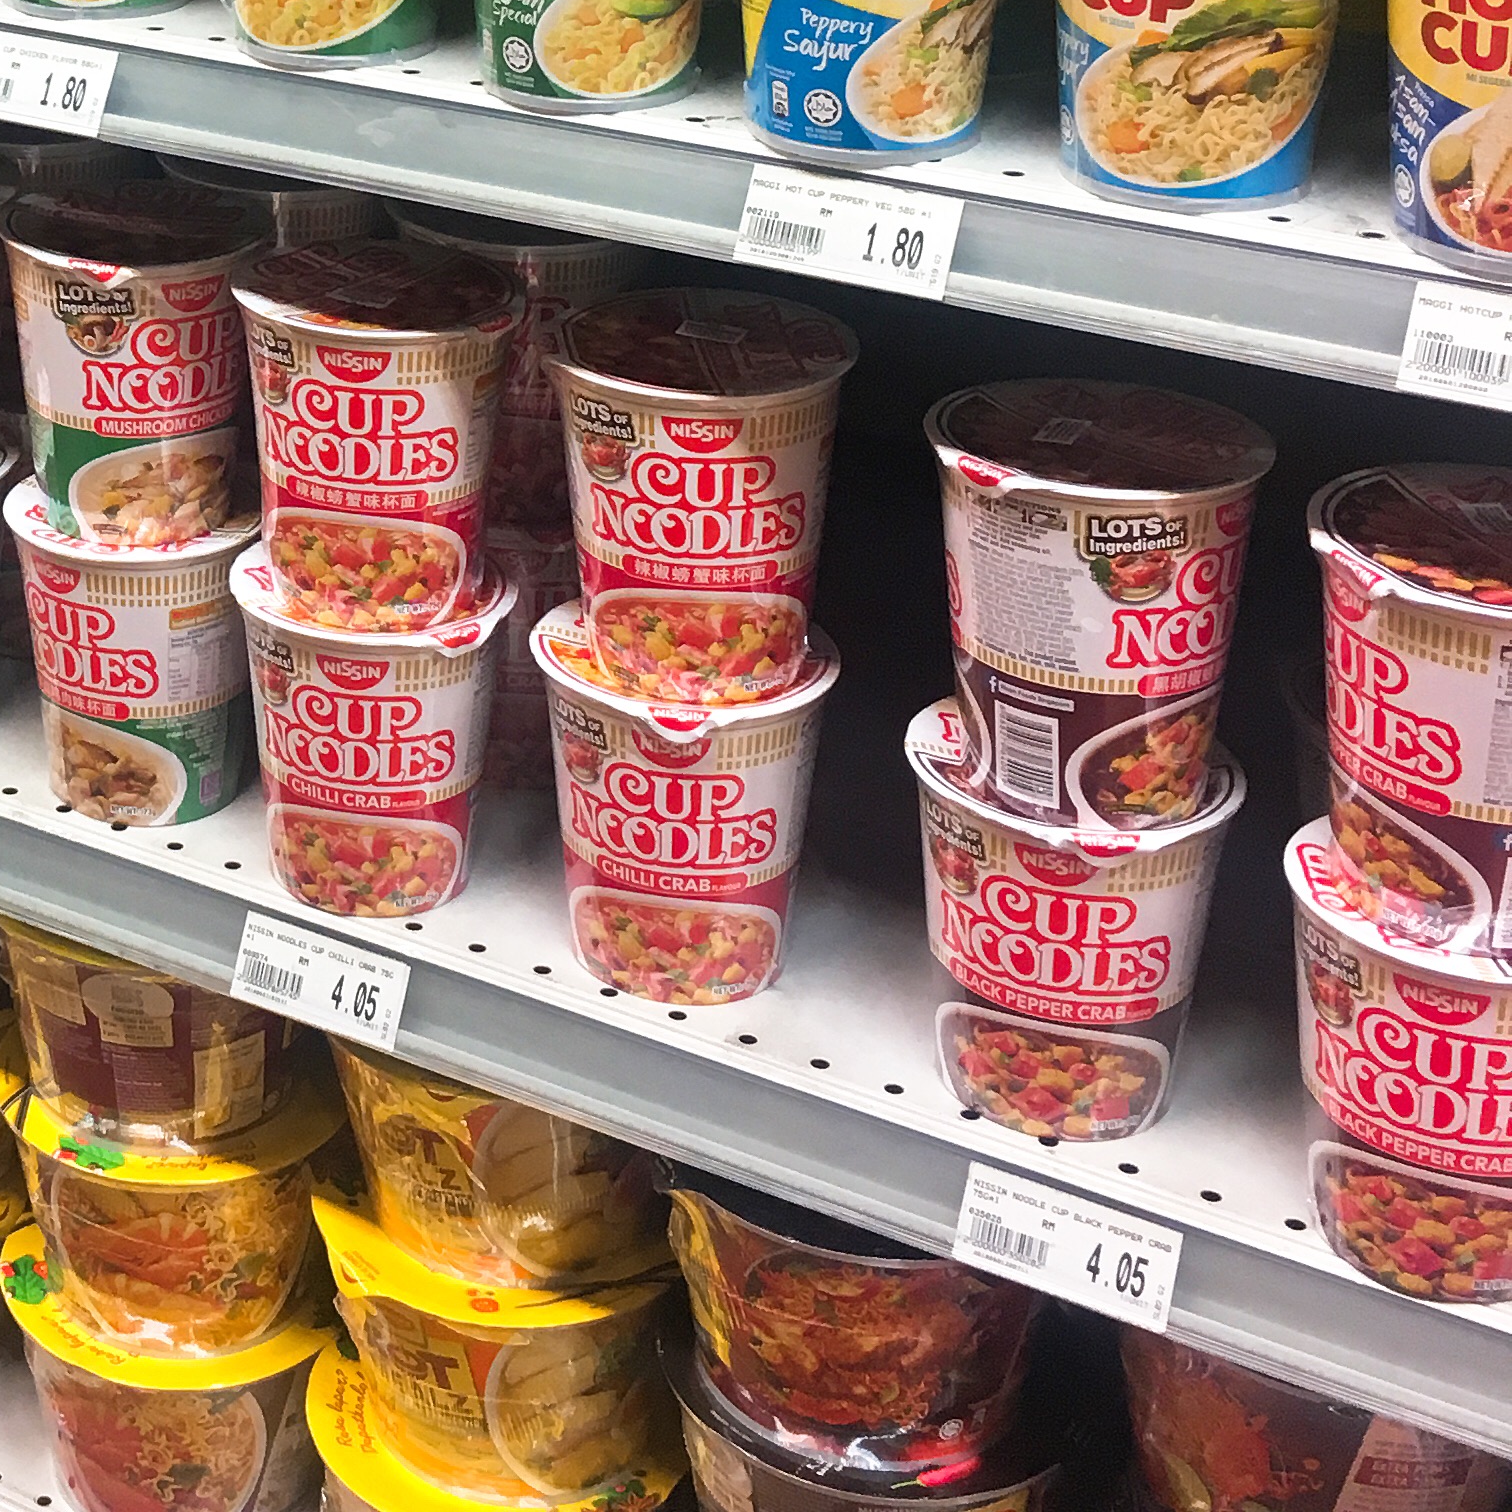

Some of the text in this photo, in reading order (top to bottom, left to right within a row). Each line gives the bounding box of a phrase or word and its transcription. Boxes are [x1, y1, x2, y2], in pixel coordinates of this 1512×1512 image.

[800, 8, 875, 45] Peppery
[783, 30, 857, 71] Sayur
[40, 74, 88, 113] 1.80
[752, 179, 781, 192] MAGGI
[786, 185, 804, 196] HOT
[807, 189, 826, 200] CUP
[829, 193, 870, 208] PEPPERY
[876, 201, 893, 212] VEG
[820, 208, 833, 218] RM
[862, 223, 925, 270] 1.80
[1419, 297, 1502, 319] MAGGI HOTCUP
[324, 352, 383, 373] NISSIN
[100, 419, 186, 436] MUSHROOM
[671, 422, 735, 442] NISSIN
[265, 417, 457, 483] NOODLES
[296, 480, 417, 509] 辣椒螃蟹味杯面
[592, 490, 804, 557] NOODLES
[1090, 517, 1184, 537] LOTS OF
[1089, 532, 1185, 555] Ingredients!
[634, 559, 766, 584] 辣椒螃蟹味杯面
[323, 660, 381, 680] NISSIN
[264, 715, 453, 784] NOODLES
[291, 777, 392, 809] CHILLI CRAB
[1361, 766, 1407, 799] CRAB
[601, 858, 711, 893] CHILLI CRAB
[248, 923, 274, 938] NISSIN
[277, 933, 308, 950] NOODLES
[310, 944, 325, 955] CUP
[328, 950, 355, 967] CHILLI
[331, 974, 380, 1021] 4.05
[954, 962, 1126, 1022] BLACK PEPPER CRAB
[974, 1178, 1008, 1197] NISSIN
[1012, 1192, 1046, 1210] NOODLE
[1051, 1205, 1069, 1217] CUP
[1073, 1213, 1102, 1229] BLACK
[1107, 1224, 1144, 1244] PEPPER
[1041, 1218, 1056, 1232] RM
[1086, 1242, 1150, 1298] 4.05
